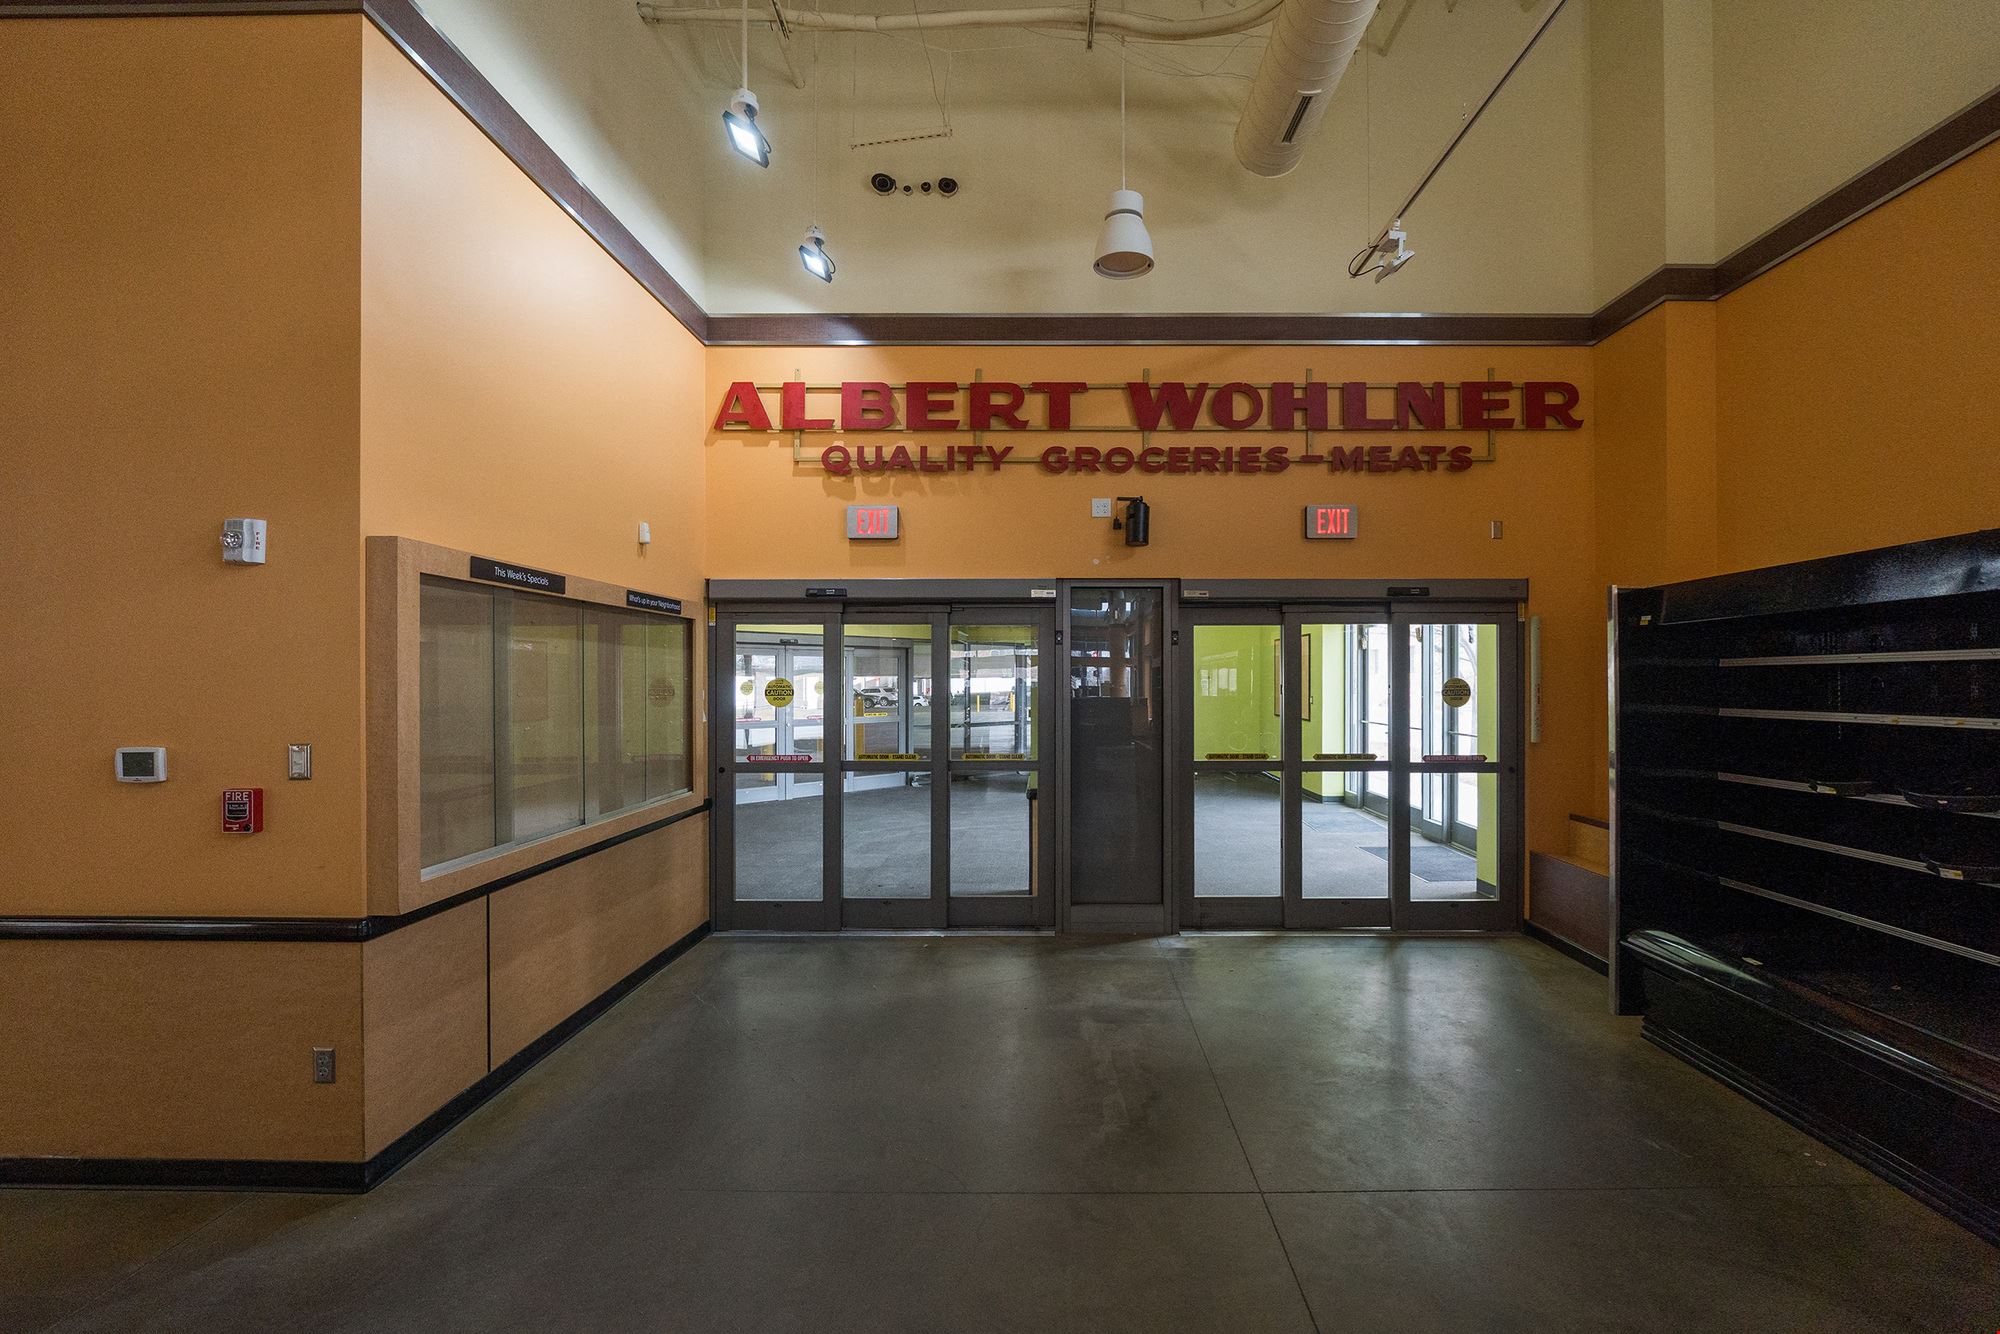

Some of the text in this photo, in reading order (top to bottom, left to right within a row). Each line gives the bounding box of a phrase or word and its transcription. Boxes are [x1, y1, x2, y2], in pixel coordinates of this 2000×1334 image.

[714, 381, 1585, 431] ALBERT WOHLNER
[821, 445, 1014, 475] QUALITY
[1041, 445, 1291, 475] GROCERIES
[1331, 445, 1473, 473] MEATS
[856, 508, 890, 534] EXIT
[1316, 508, 1350, 535] EXIT
[495, 566, 549, 586] This Week's Specials
[225, 792, 249, 801] FIRE
